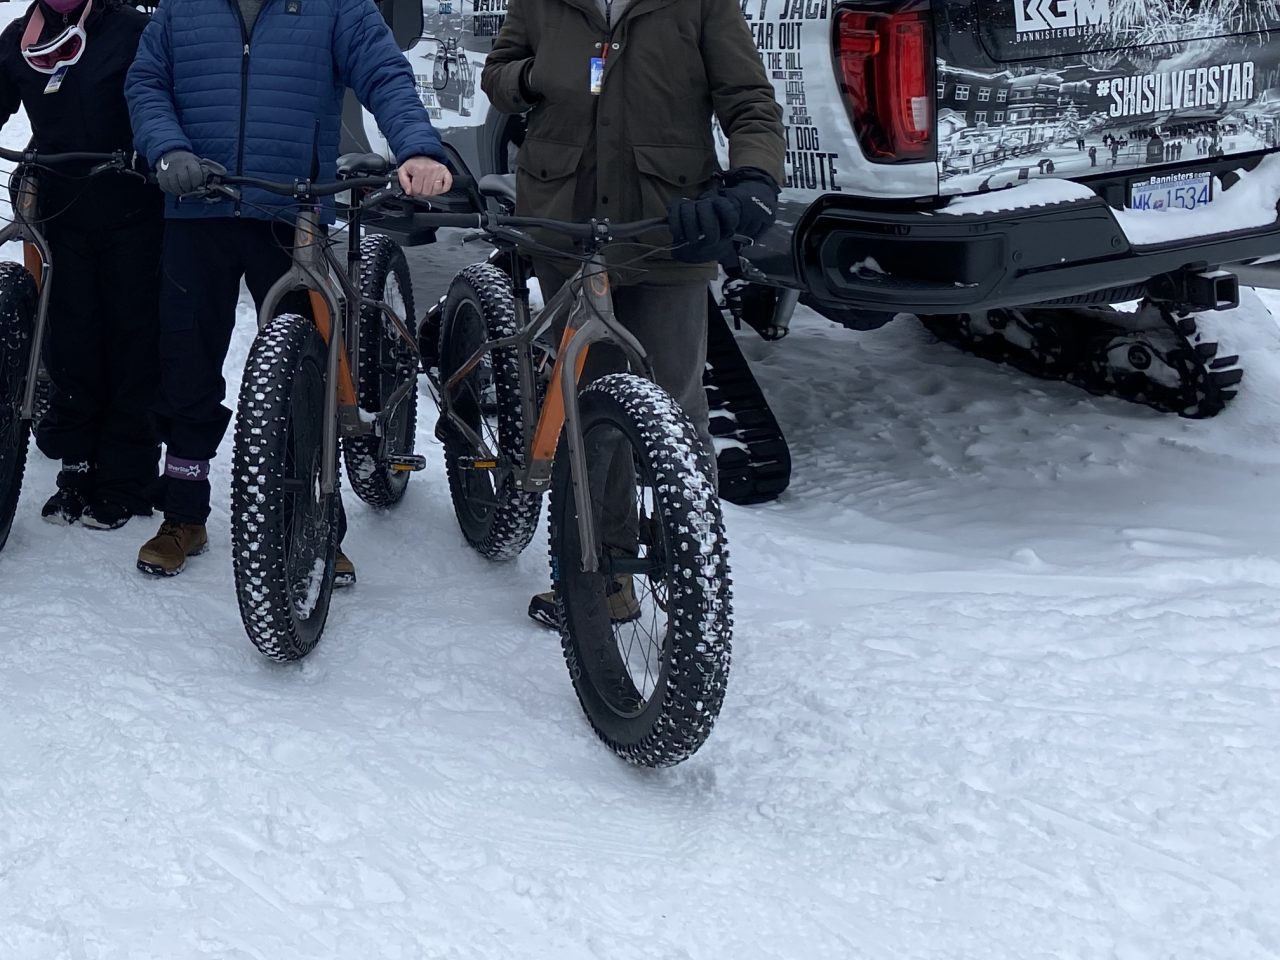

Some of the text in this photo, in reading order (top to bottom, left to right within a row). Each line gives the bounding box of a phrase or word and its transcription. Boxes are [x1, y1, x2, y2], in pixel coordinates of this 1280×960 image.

[779, 22, 803, 50] OUT
[1016, 29, 1067, 43] BANNISTER
[767, 52, 782, 70] THE
[785, 52, 803, 70] HILL
[785, 81, 805, 93] LITTLE
[1096, 61, 1255, 118] #SKISILVERSTAR
[796, 126, 820, 151] DOG
[783, 151, 842, 191] CHUTE
